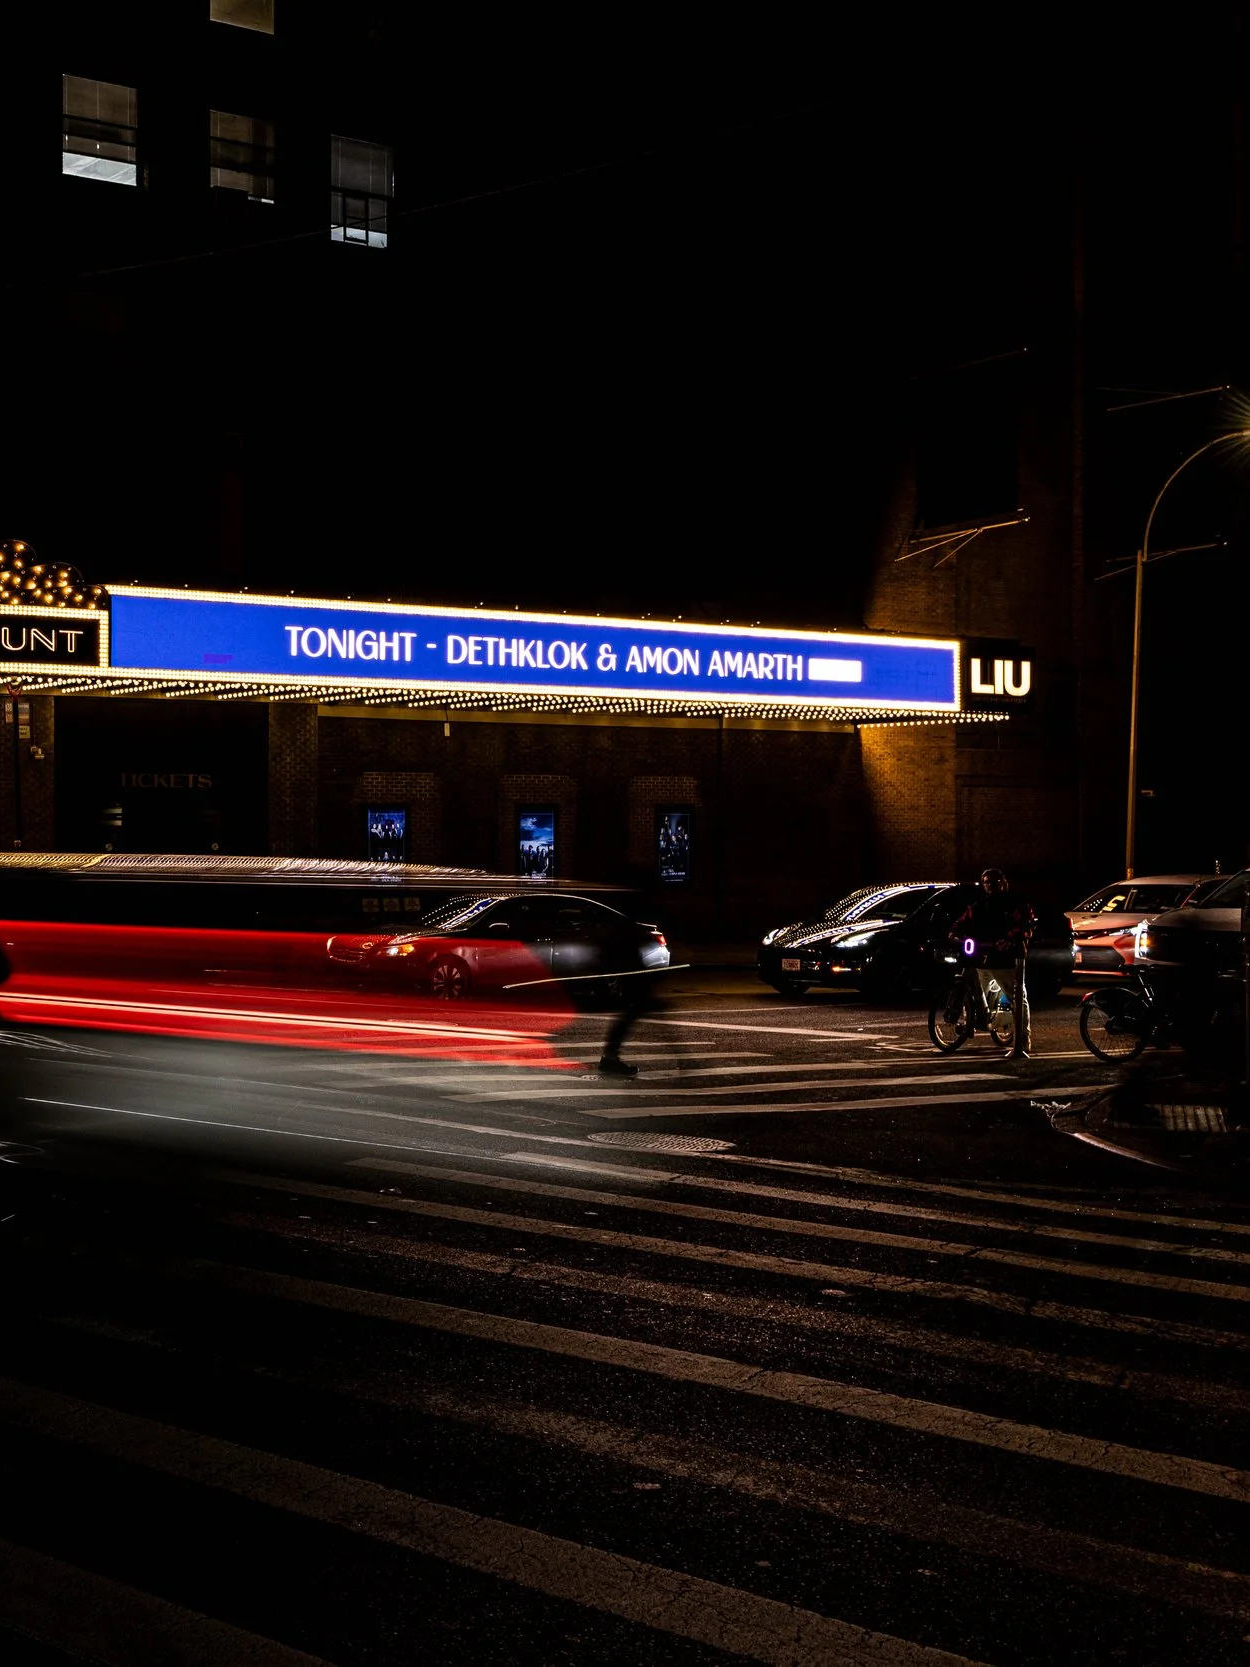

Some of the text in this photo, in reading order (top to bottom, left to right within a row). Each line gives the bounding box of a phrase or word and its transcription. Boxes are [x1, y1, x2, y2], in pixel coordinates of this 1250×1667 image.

[284, 625, 417, 662] TONIGHT
[446, 634, 589, 671] DETHKLOK
[596, 643, 617, 672] &
[625, 645, 699, 677] AMON
[707, 650, 804, 682] AMARTH
[970, 657, 1031, 697] LIU
[117, 772, 213, 789] TICKETS
